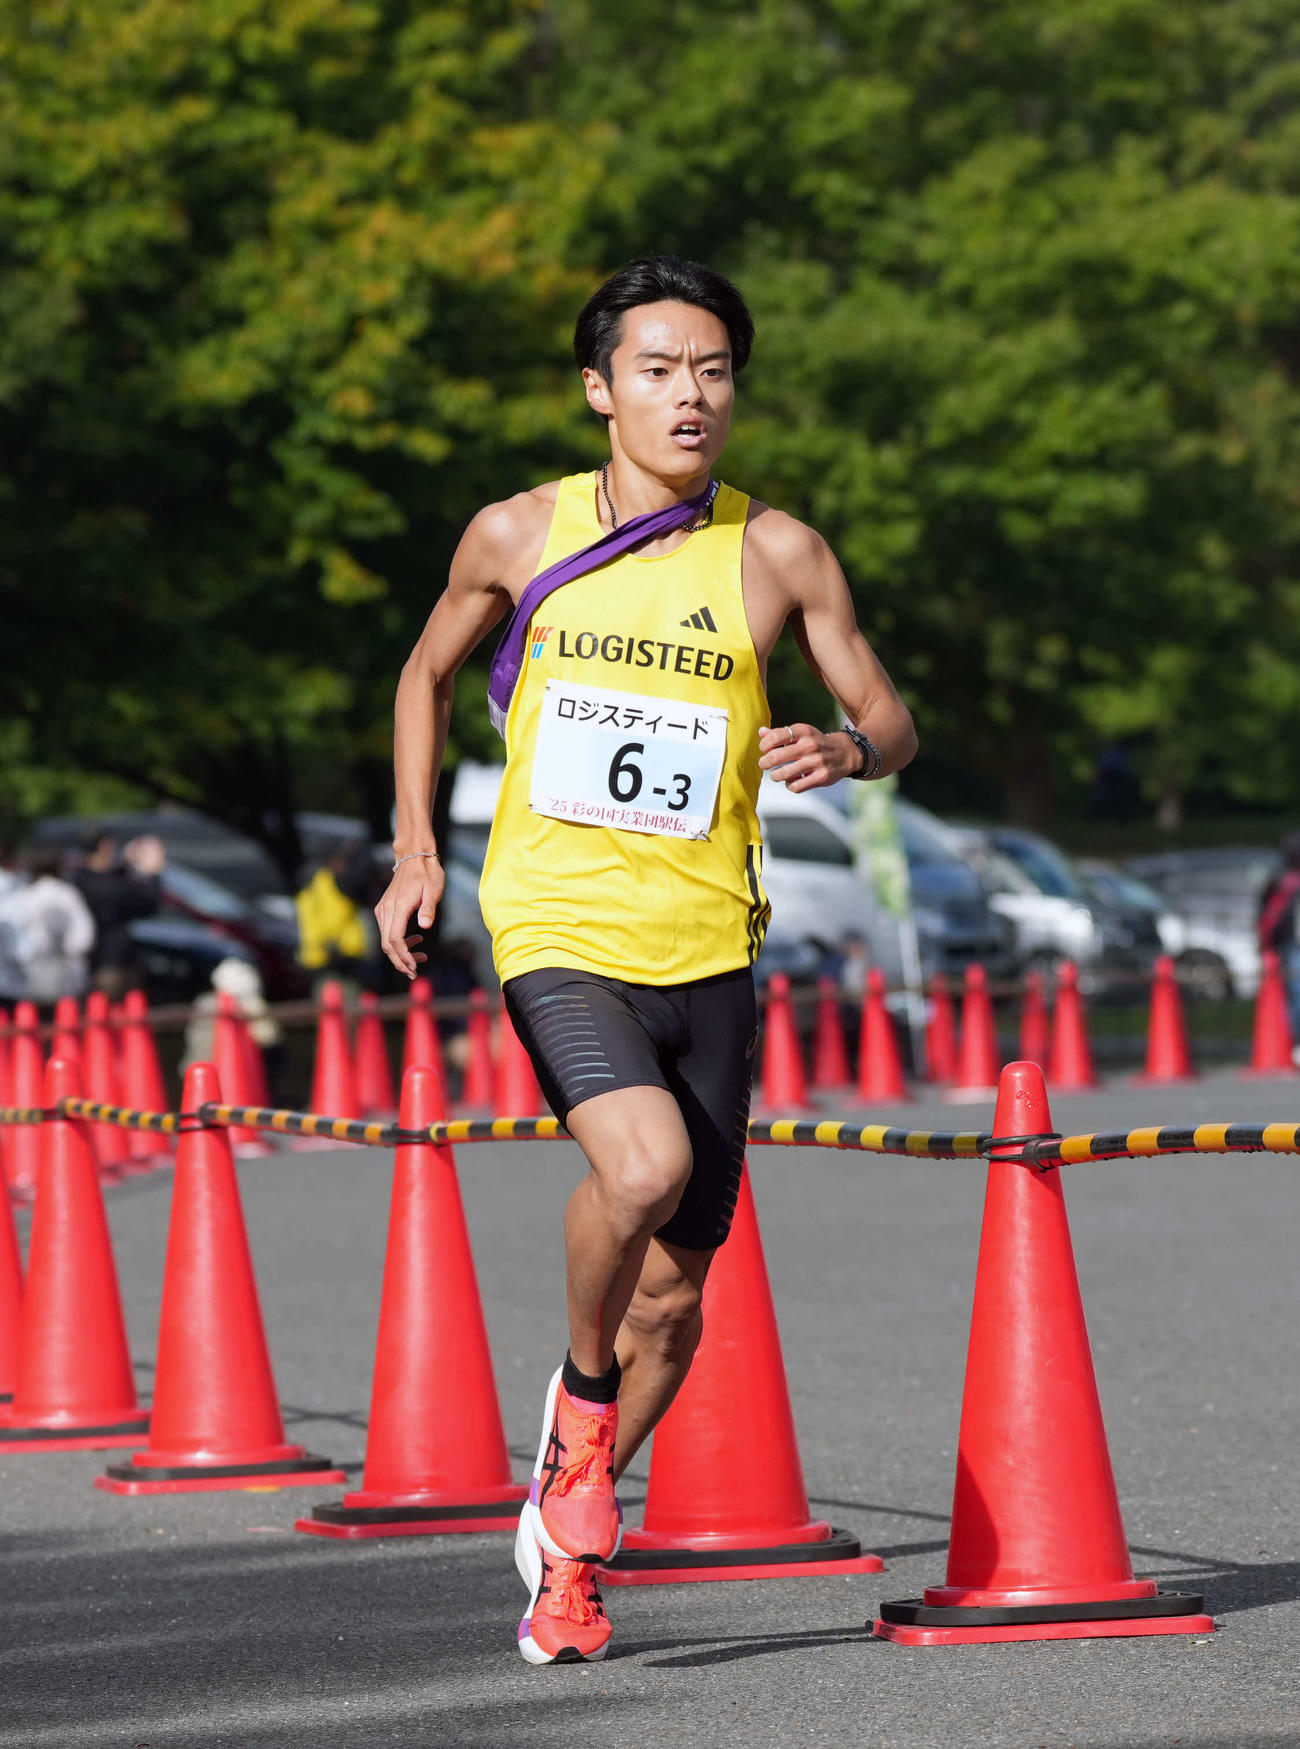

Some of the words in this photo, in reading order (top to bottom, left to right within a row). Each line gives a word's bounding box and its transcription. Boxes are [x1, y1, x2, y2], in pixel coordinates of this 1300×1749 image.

[558, 630, 734, 681] LOGISTEED
[557, 698, 709, 740] ロジスティード
